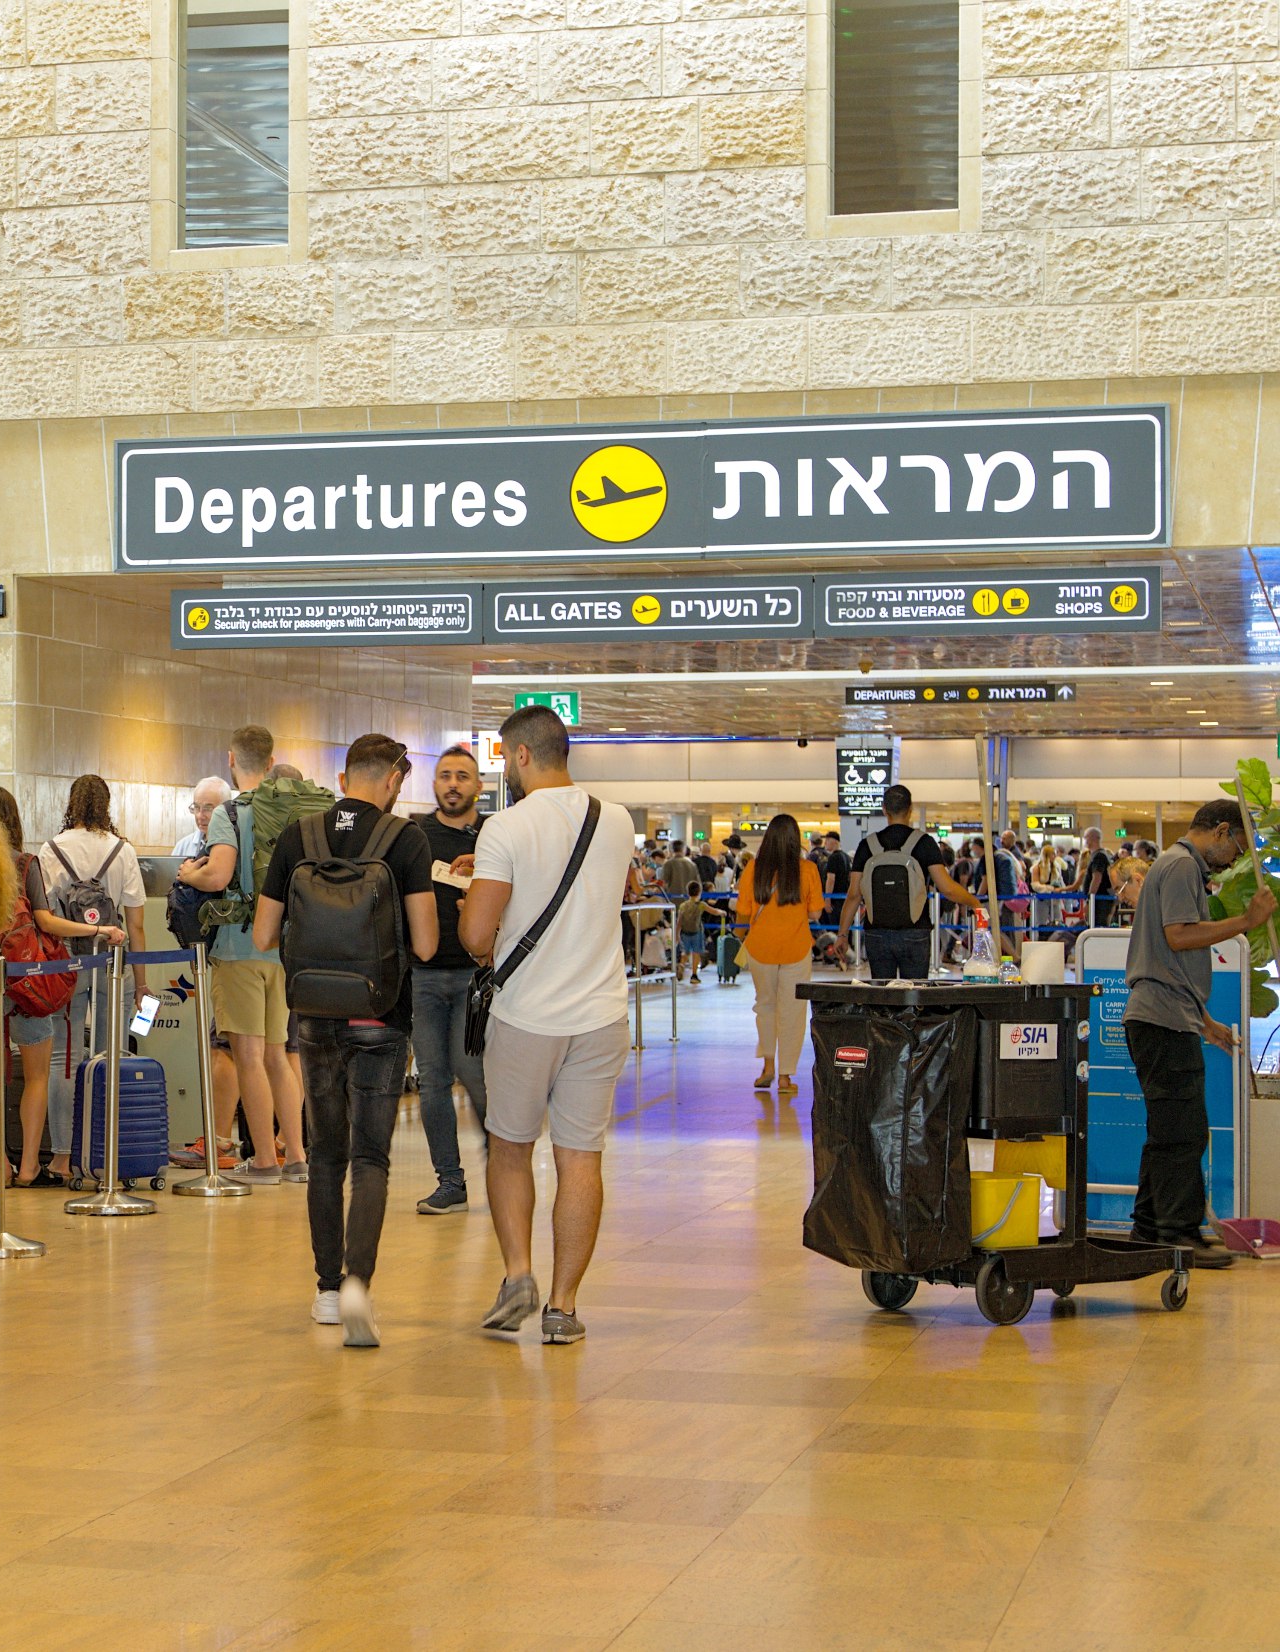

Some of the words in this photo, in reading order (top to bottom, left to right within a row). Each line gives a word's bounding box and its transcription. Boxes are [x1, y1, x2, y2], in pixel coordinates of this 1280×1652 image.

[712, 449, 1111, 520] המראות
[154, 474, 528, 548] Departures
[871, 589, 903, 602] ובתי
[906, 588, 966, 602] מסעדות
[1058, 585, 1102, 597] חנויות
[836, 590, 868, 606] קפה
[264, 606, 302, 617] כבודת
[305, 606, 324, 617] עם
[328, 602, 378, 617] לנוסעים
[382, 603, 428, 615] ביטחוני
[431, 603, 466, 616] בידוק
[504, 603, 545, 622] ALL
[550, 601, 622, 621] GATES
[670, 598, 758, 621] השערים
[765, 594, 792, 617] כל
[838, 607, 876, 619] FOOD
[879, 606, 889, 618] &
[892, 605, 966, 618] BEVERAGE
[1055, 602, 1103, 615] SHOPS
[214, 606, 245, 619] בלבד
[248, 608, 260, 618] יד
[214, 619, 250, 631] Security
[251, 619, 279, 629] check
[279, 618, 293, 629] for
[294, 619, 345, 631] passengers
[347, 617, 366, 627] with
[367, 616, 406, 628] Carry-on
[408, 616, 444, 628] baggage
[446, 615, 466, 627] only
[853, 689, 916, 701] DEPARTURES
[987, 686, 1047, 699] המראות
[1018, 1047, 1039, 1056] ניקיון
